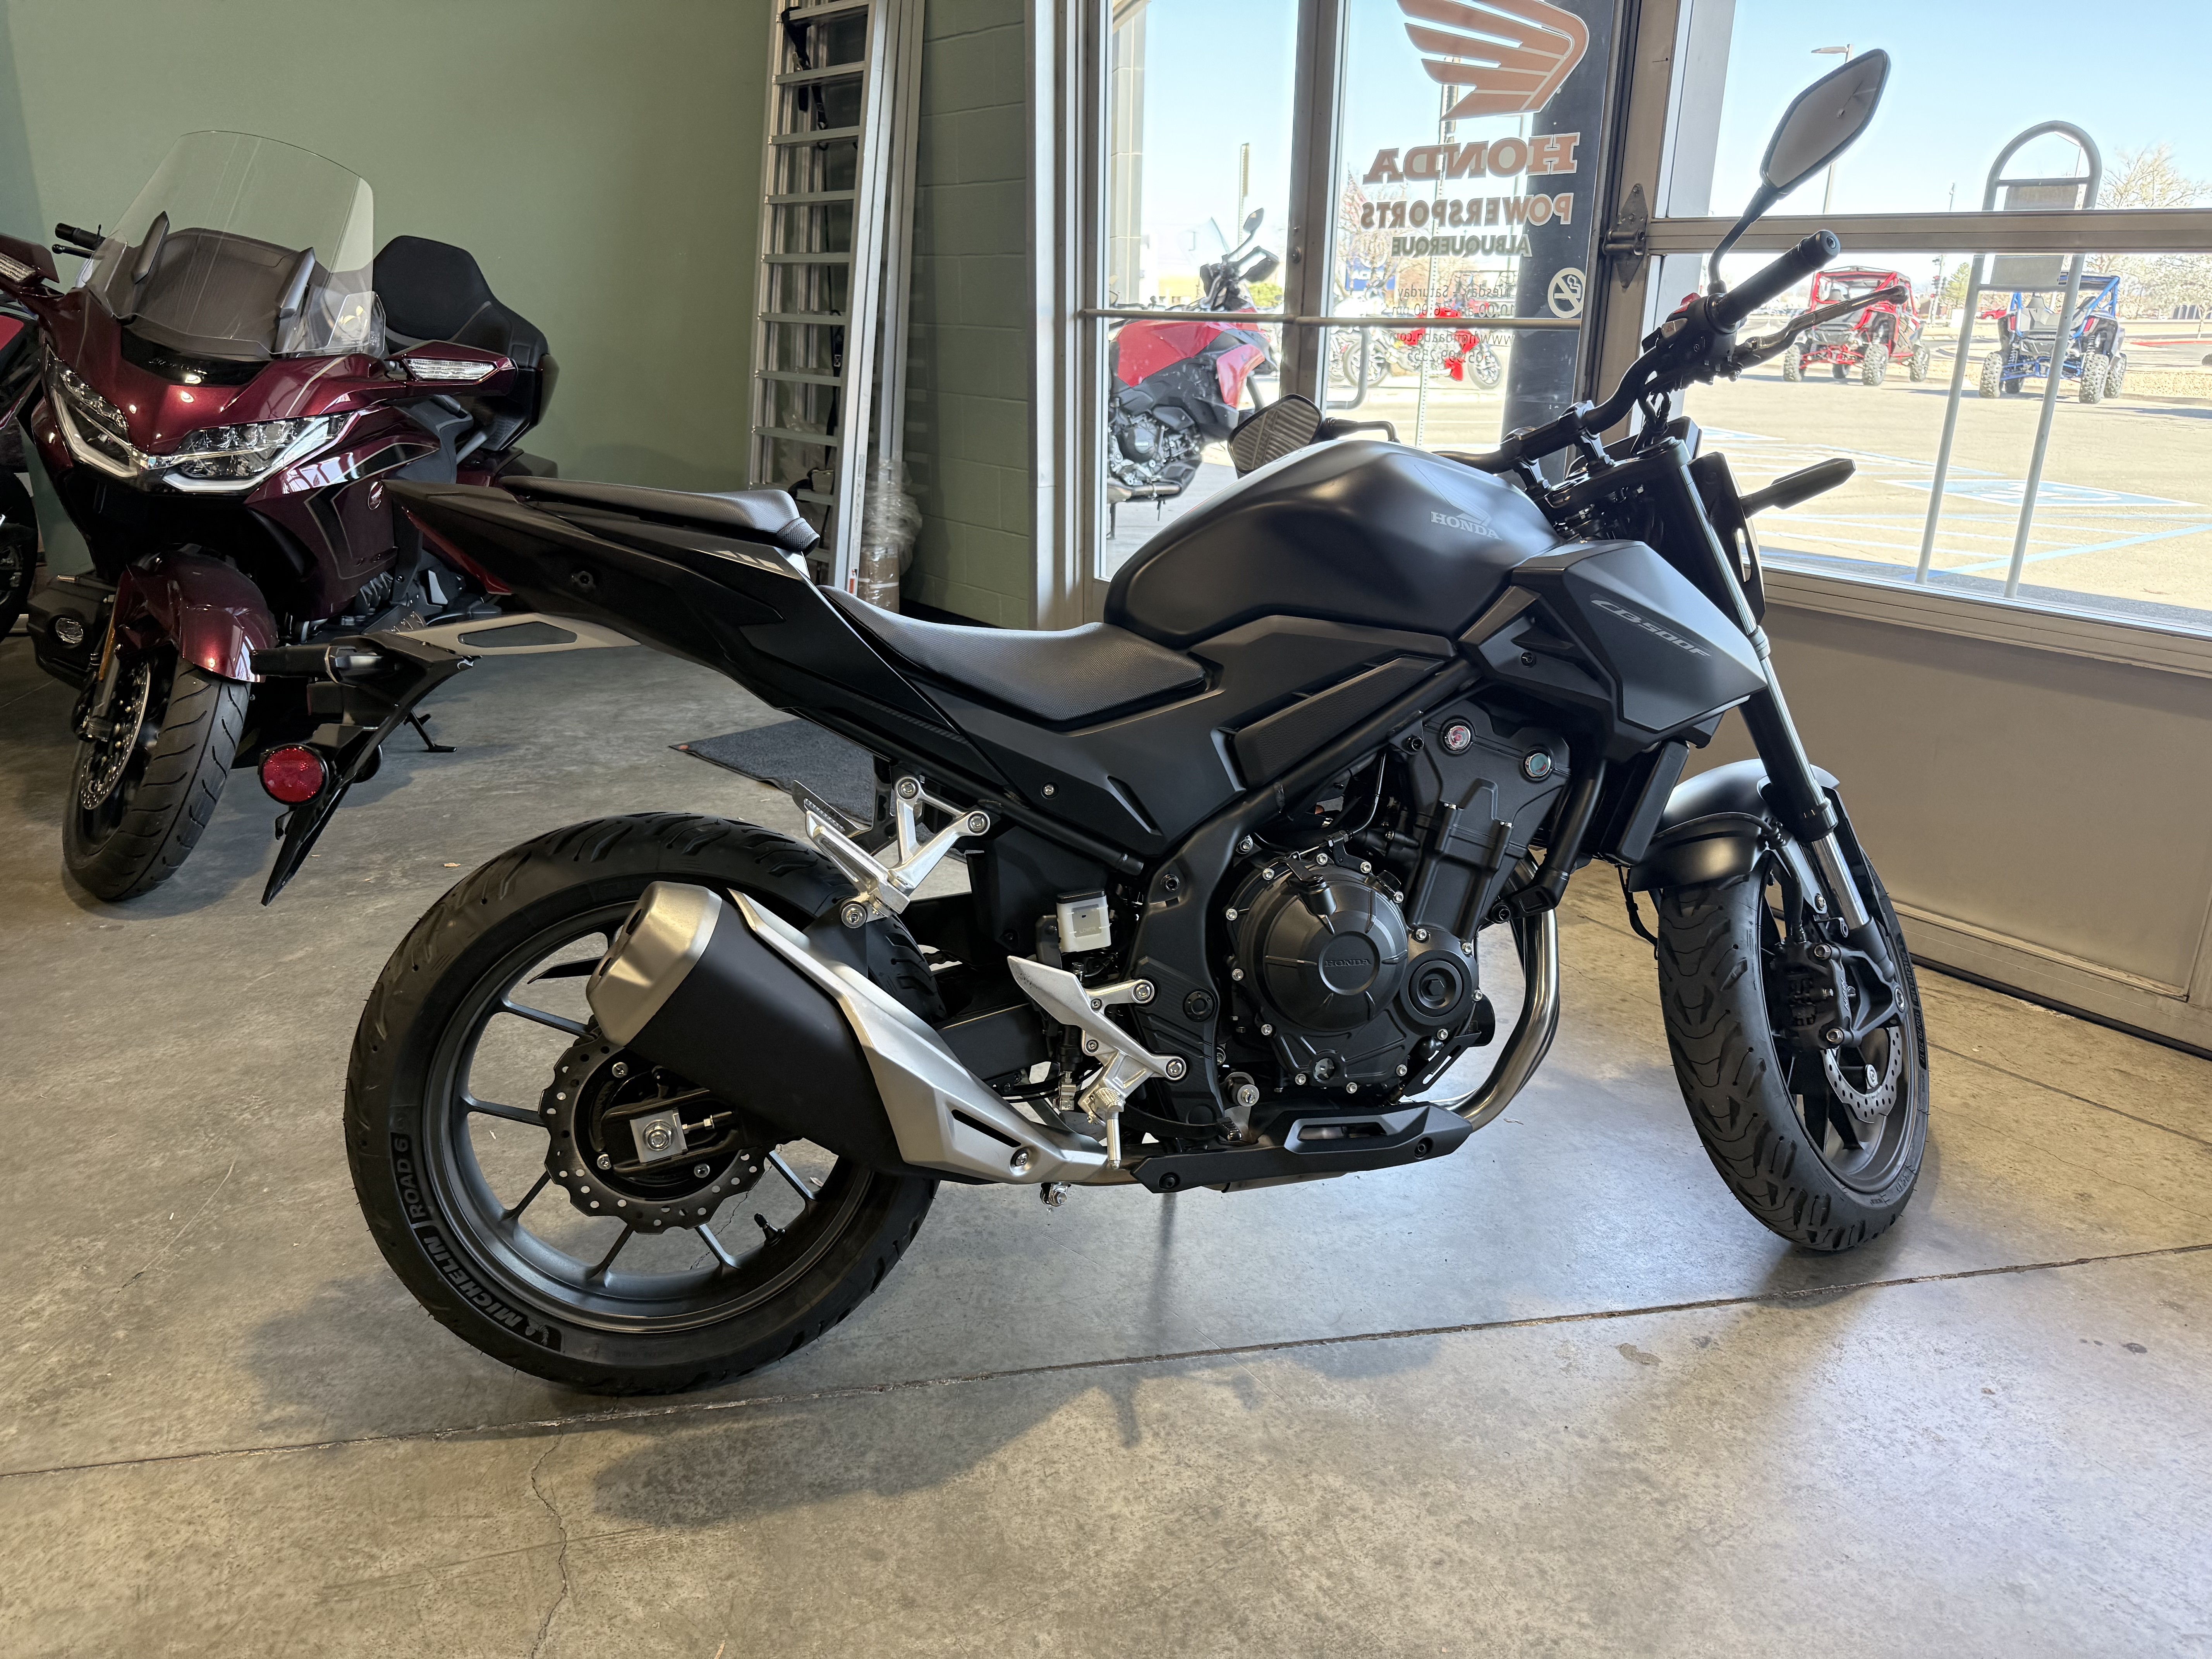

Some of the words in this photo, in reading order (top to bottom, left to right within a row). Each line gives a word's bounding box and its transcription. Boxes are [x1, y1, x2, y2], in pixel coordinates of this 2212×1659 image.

[1431, 511, 1502, 541] HONDA
[1591, 600, 1711, 656] CB500F
[395, 1138, 408, 1152] 6
[397, 1159, 426, 1218] ROAD
[424, 1237, 523, 1327] MICHELIN
